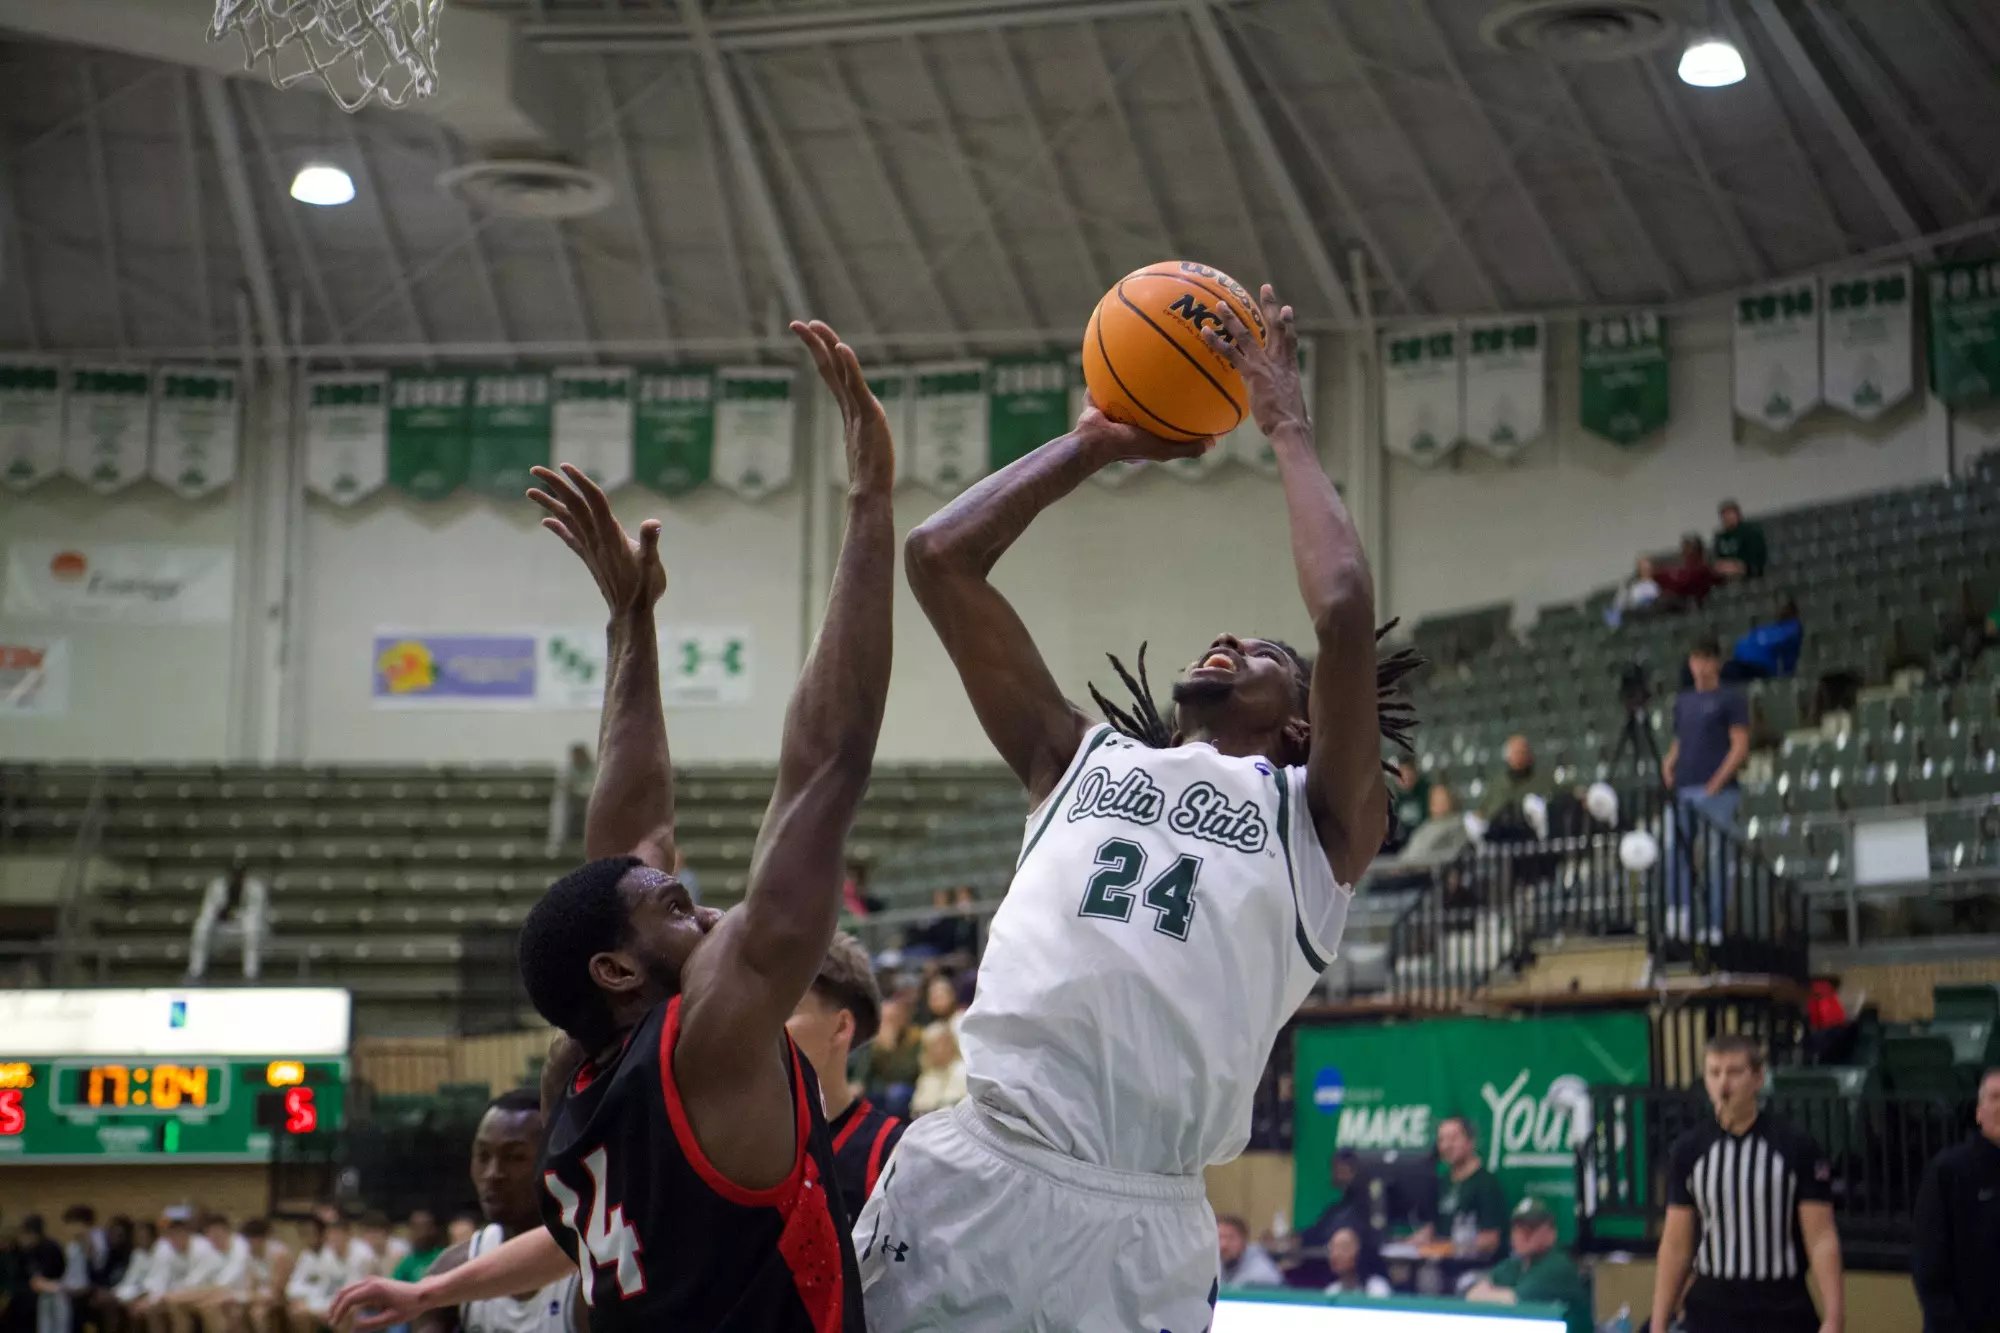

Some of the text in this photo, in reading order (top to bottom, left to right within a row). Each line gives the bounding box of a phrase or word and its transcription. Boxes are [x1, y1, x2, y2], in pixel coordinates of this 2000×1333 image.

[1067, 766, 1165, 826] Delta
[1168, 781, 1268, 853] State
[1078, 837, 1204, 942] 24
[87, 1063, 208, 1109] 17:04
[284, 1086, 317, 1134] 5
[1335, 1104, 1431, 1149] MAKE
[544, 1143, 648, 1308] 14
